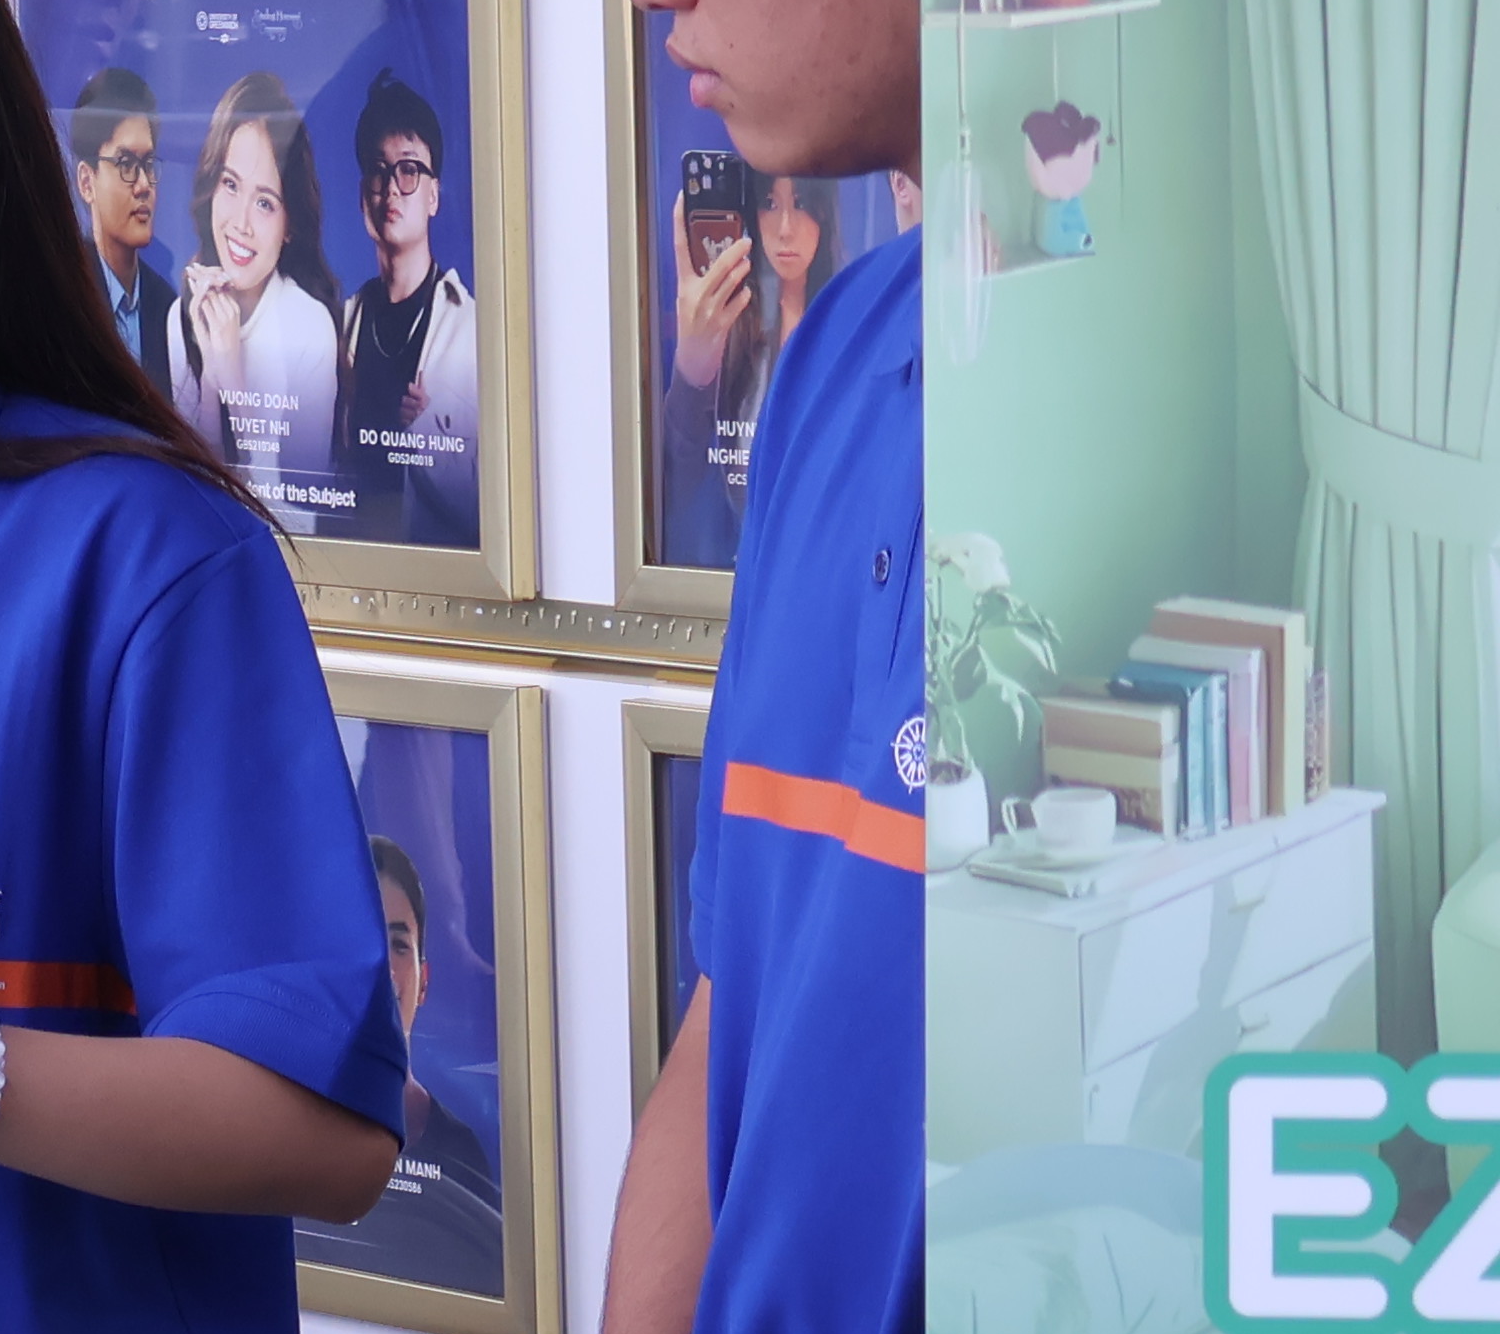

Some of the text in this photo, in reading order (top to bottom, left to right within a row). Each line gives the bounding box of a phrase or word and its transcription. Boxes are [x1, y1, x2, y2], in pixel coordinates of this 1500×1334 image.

[219, 390, 299, 410] VUONG DOAN
[229, 416, 290, 436] TUYET NHI
[359, 429, 465, 453] DO QUANG HUNG
[273, 484, 285, 500] of
[287, 484, 307, 503] the
[309, 486, 356, 508] Subject
[406, 1160, 441, 1180] MANH
